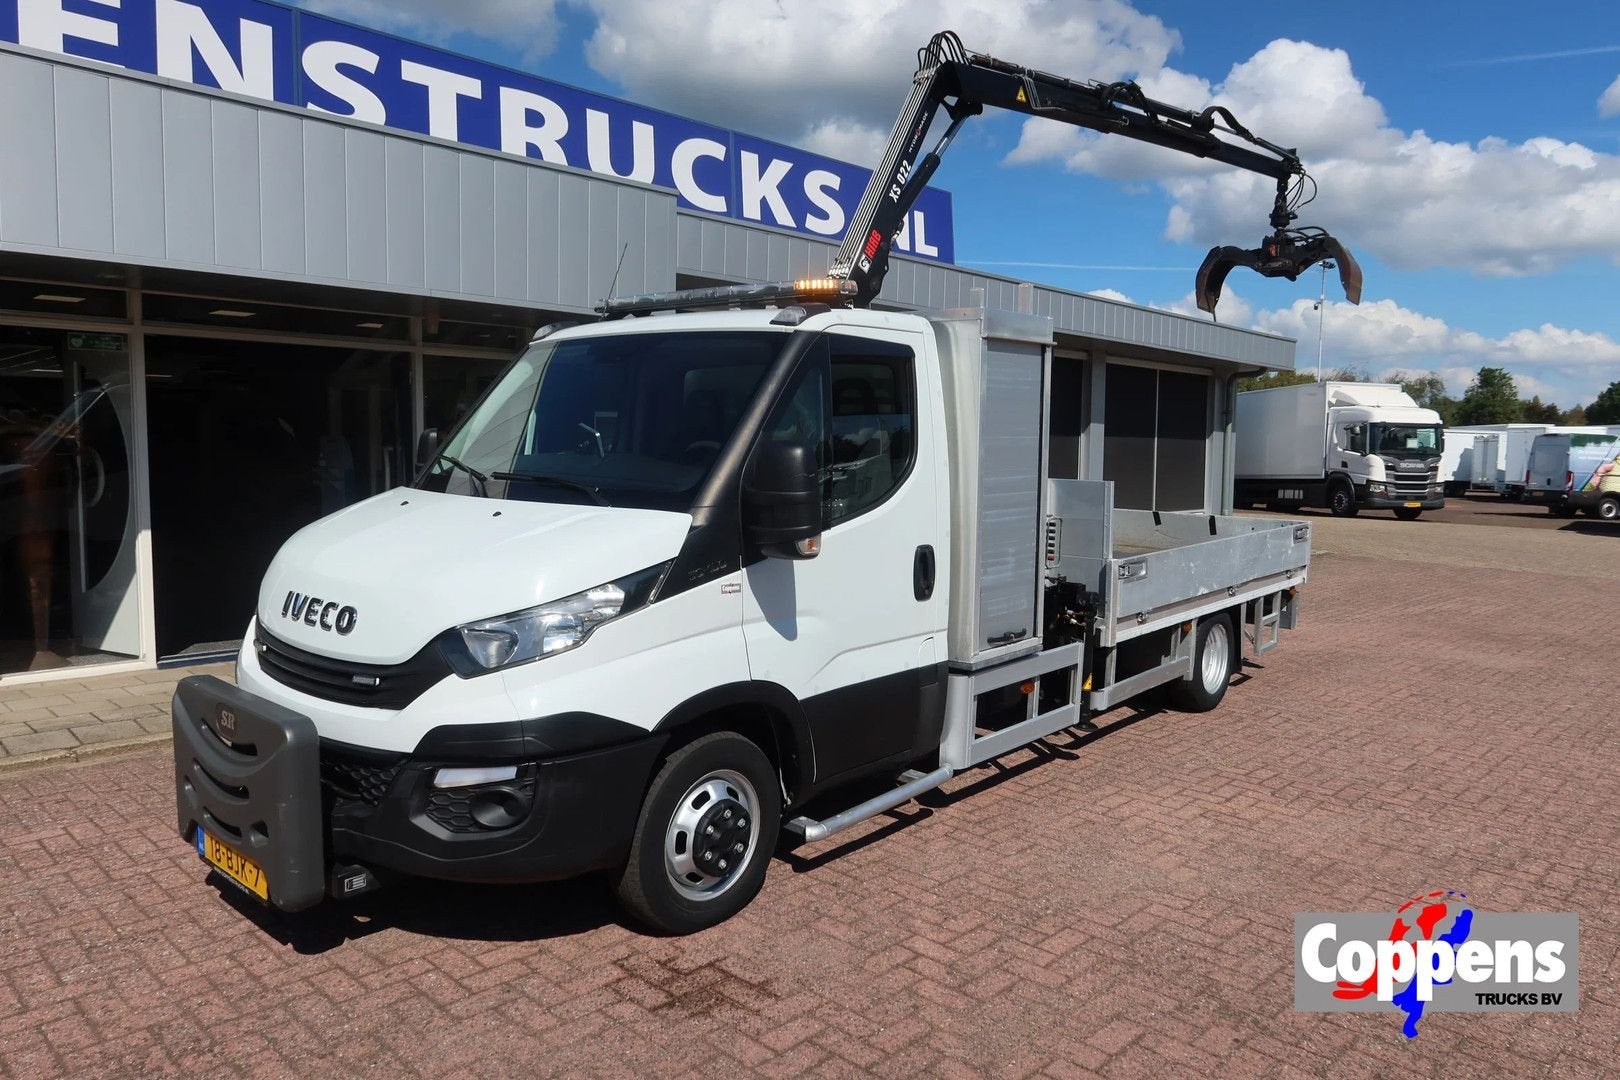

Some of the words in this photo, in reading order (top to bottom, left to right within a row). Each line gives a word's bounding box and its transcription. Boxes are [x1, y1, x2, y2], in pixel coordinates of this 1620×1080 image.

[18, 0, 939, 257] ENSTRUCKSNL
[888, 183, 902, 203] XS
[897, 160, 912, 184] 022
[864, 229, 882, 258] HIAB
[281, 590, 358, 636] IVECO
